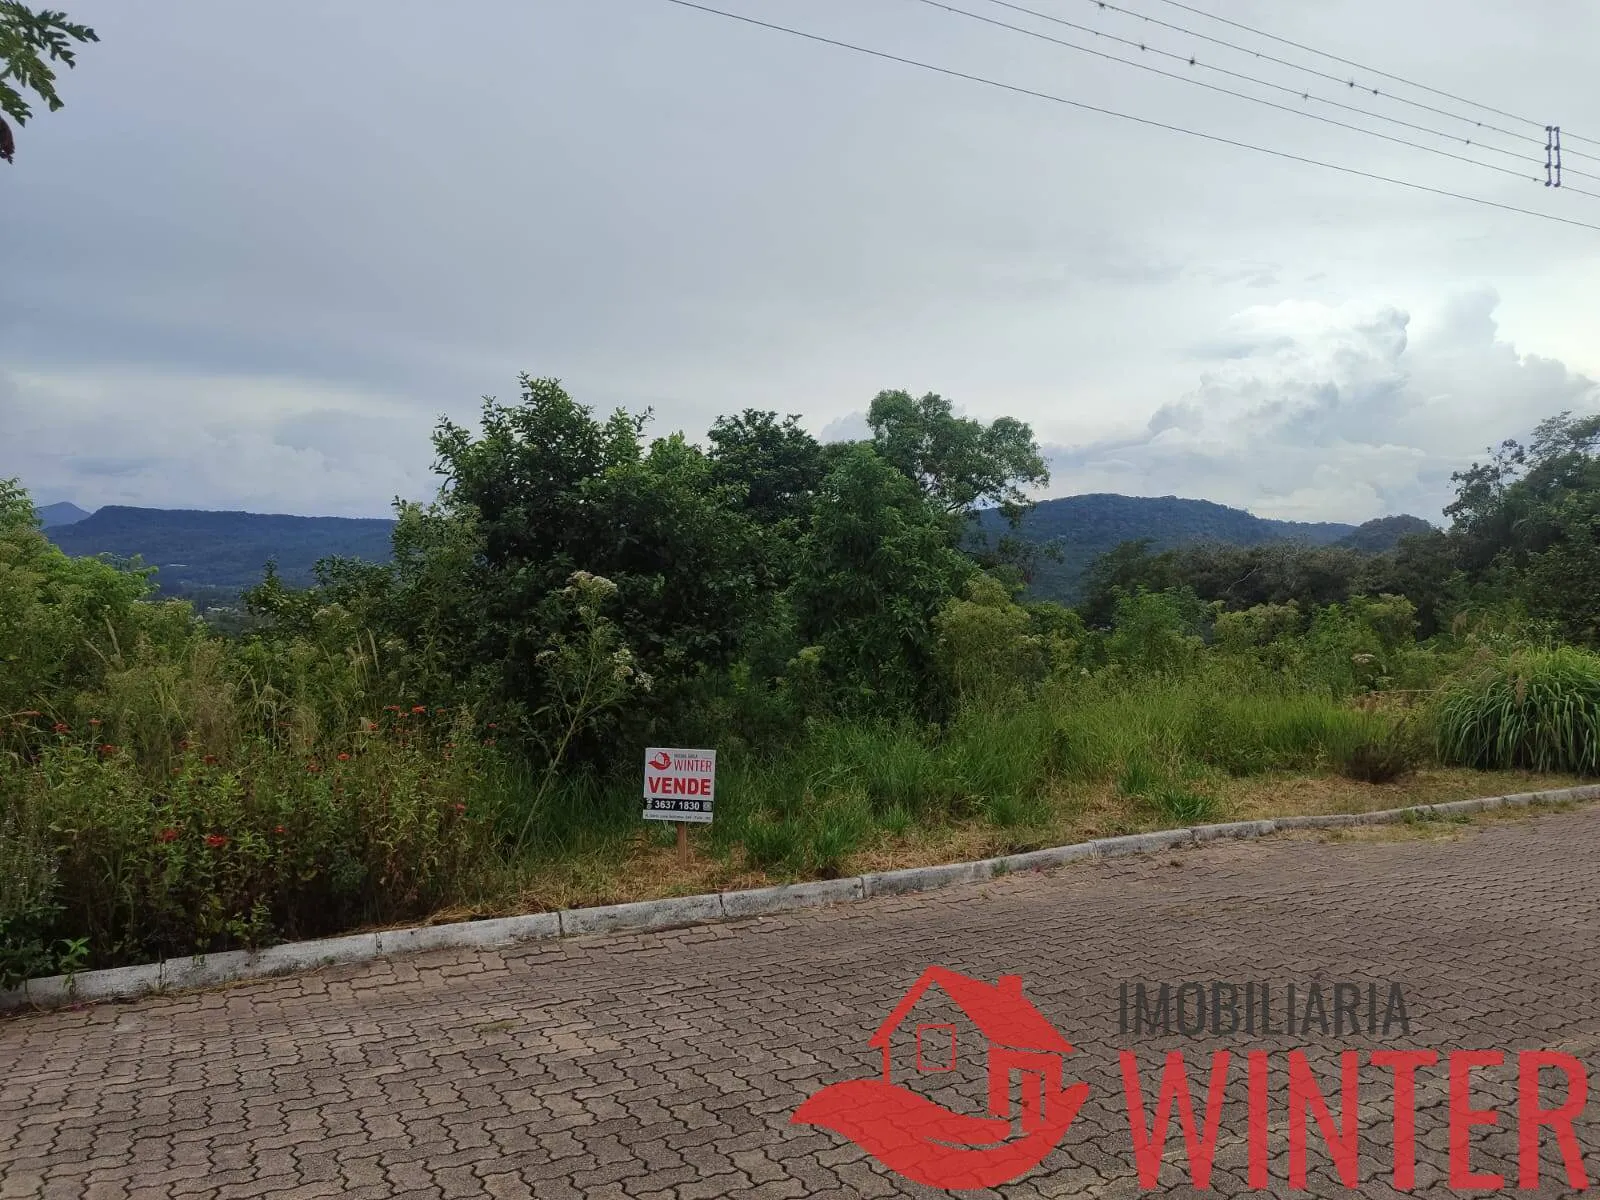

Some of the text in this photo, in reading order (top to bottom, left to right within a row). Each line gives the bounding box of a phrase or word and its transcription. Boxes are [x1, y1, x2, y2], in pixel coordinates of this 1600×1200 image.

[674, 760, 712, 772] WINTER
[648, 777, 711, 796] VENDE
[655, 800, 700, 810] 3637 1830
